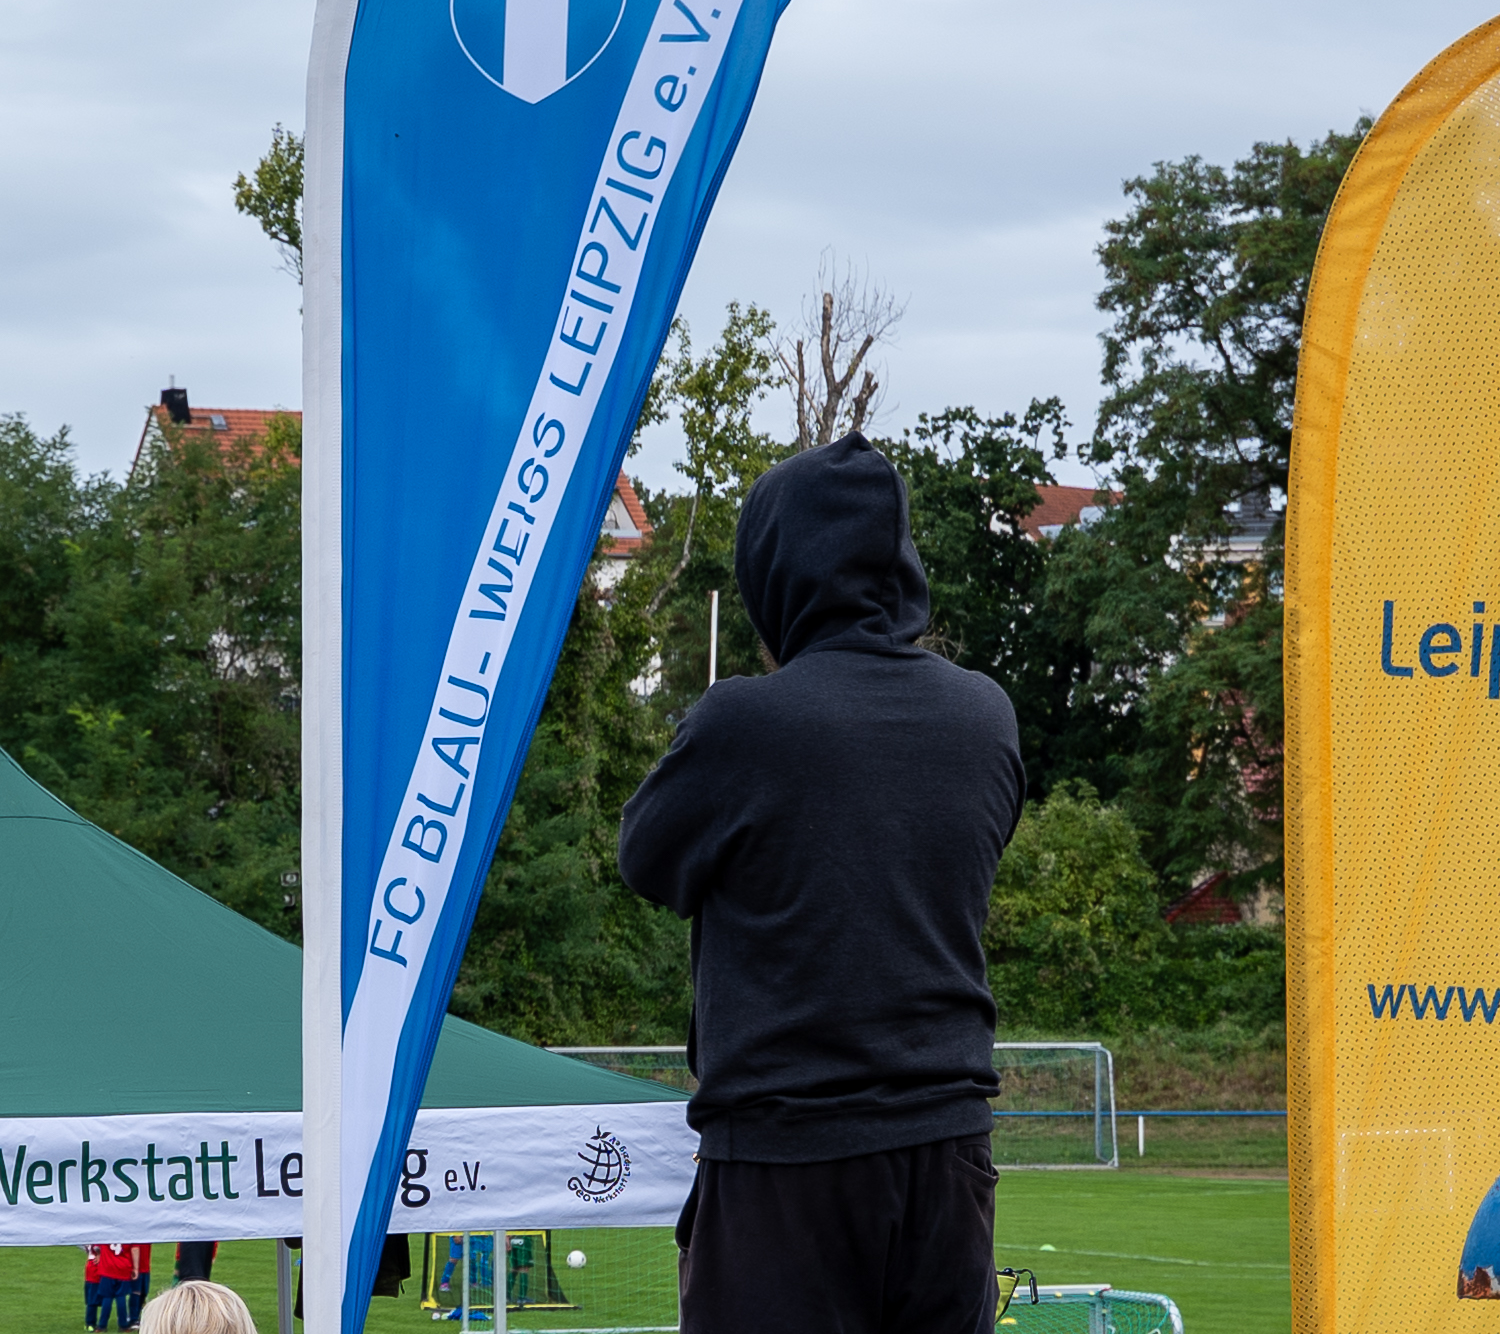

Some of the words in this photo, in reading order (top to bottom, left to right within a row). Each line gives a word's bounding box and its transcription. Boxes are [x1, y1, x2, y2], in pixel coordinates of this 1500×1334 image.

[369, 876, 426, 968] FC
[468, 410, 566, 621] WEISS
[548, 129, 668, 397] LEIPZIG
[444, 1160, 487, 1192] e.V.
